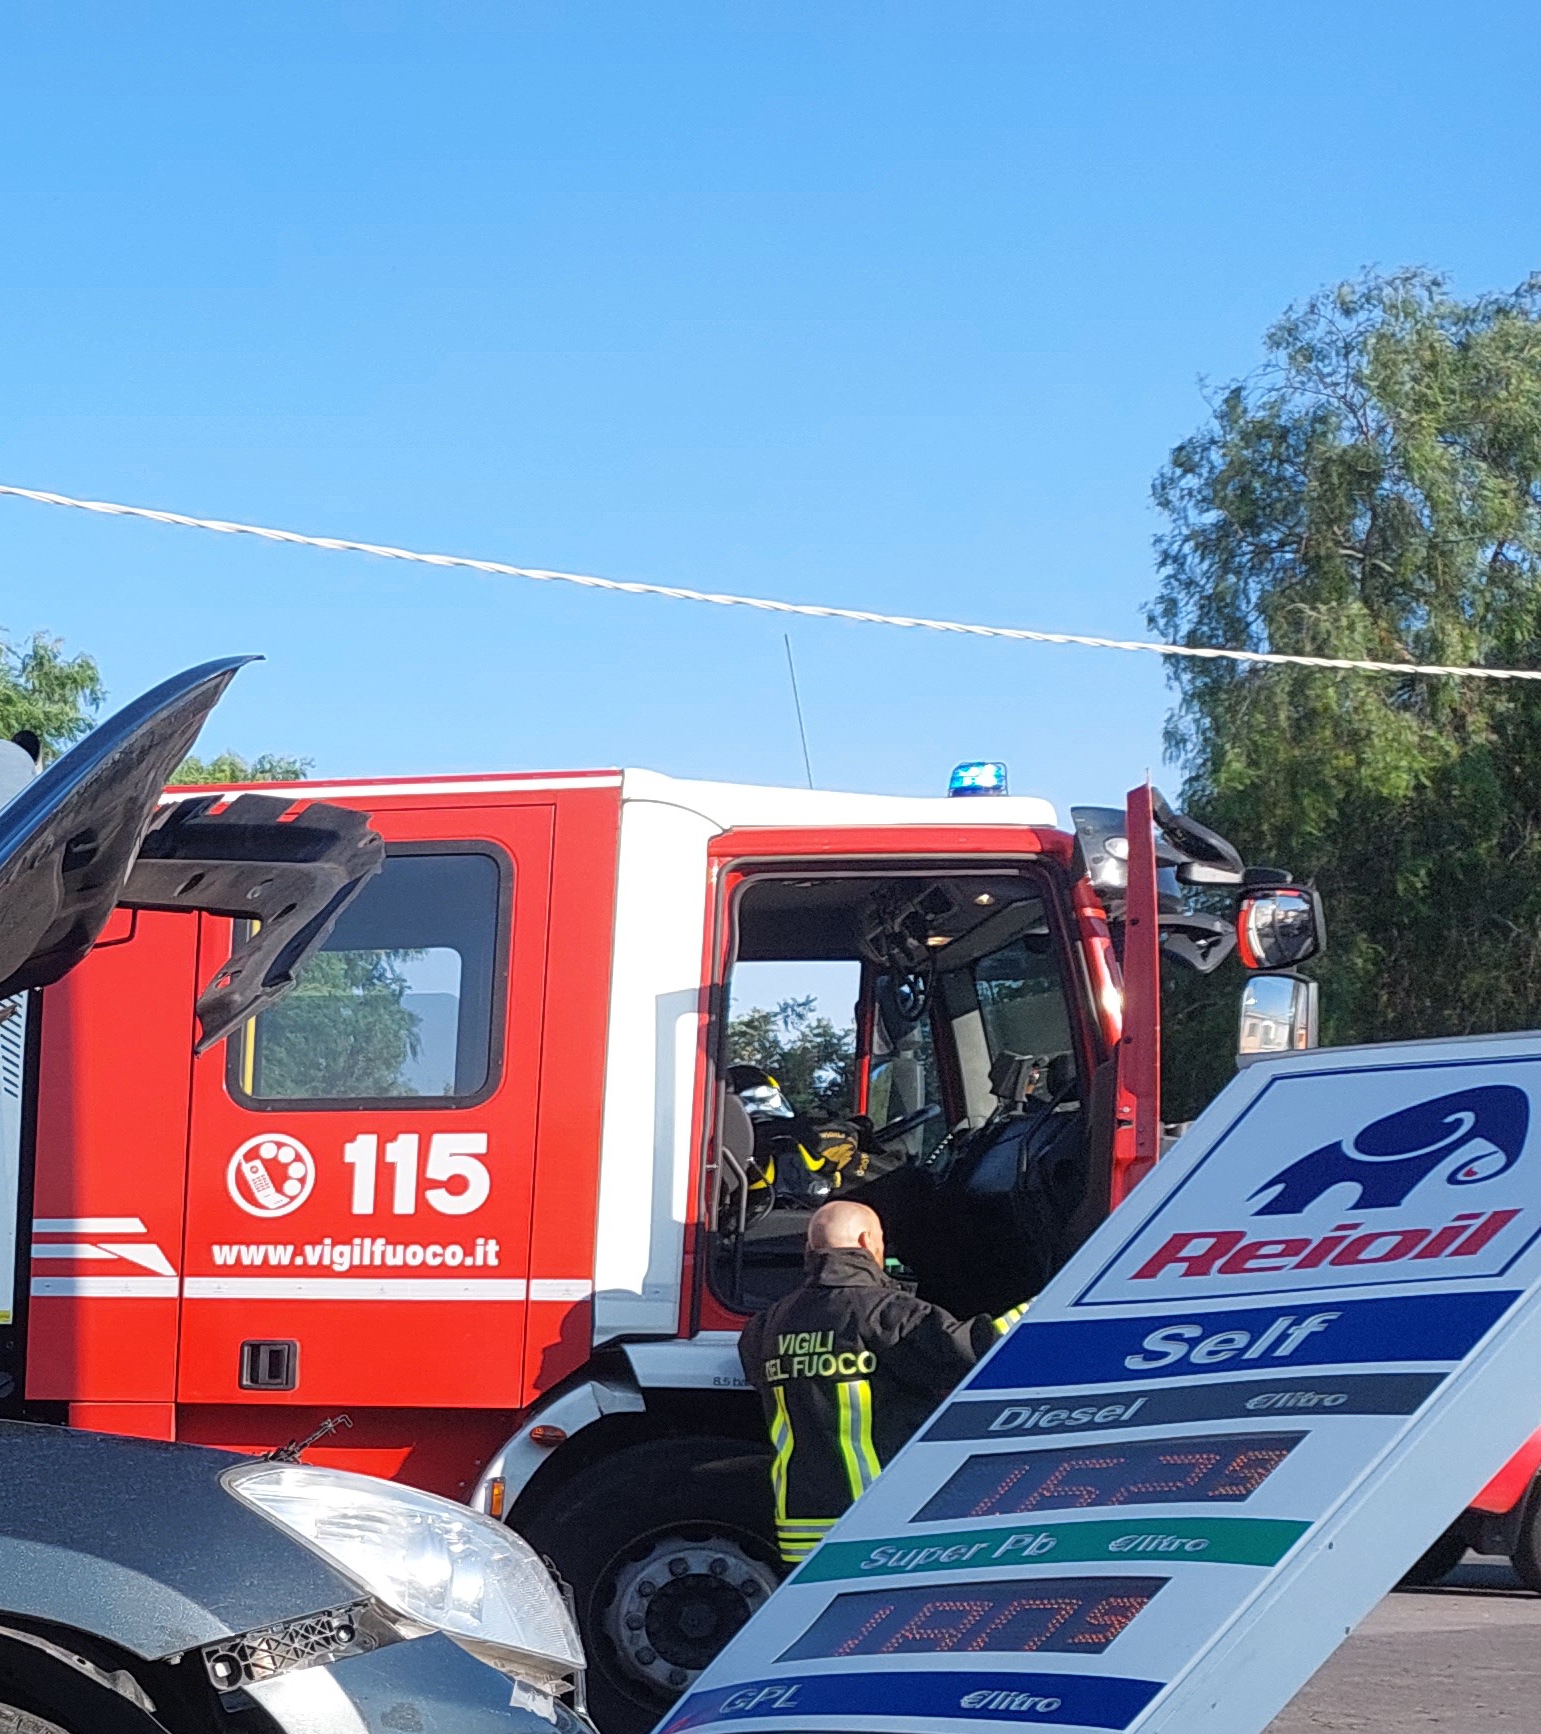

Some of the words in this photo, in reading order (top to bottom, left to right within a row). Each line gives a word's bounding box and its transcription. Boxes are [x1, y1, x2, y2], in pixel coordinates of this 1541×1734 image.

[344, 1133, 490, 1215] 115
[212, 1237, 500, 1271] www.vigilfuoco.it
[1127, 1208, 1525, 1281] Reioil
[778, 1330, 835, 1356] VIGILI
[1124, 1311, 1344, 1370] Self
[792, 1351, 878, 1378] FUOCO
[987, 1396, 1149, 1432] Diesel
[860, 1541, 993, 1571] Super
[991, 1531, 1058, 1559] Pb
[719, 1683, 803, 1714] GPL
